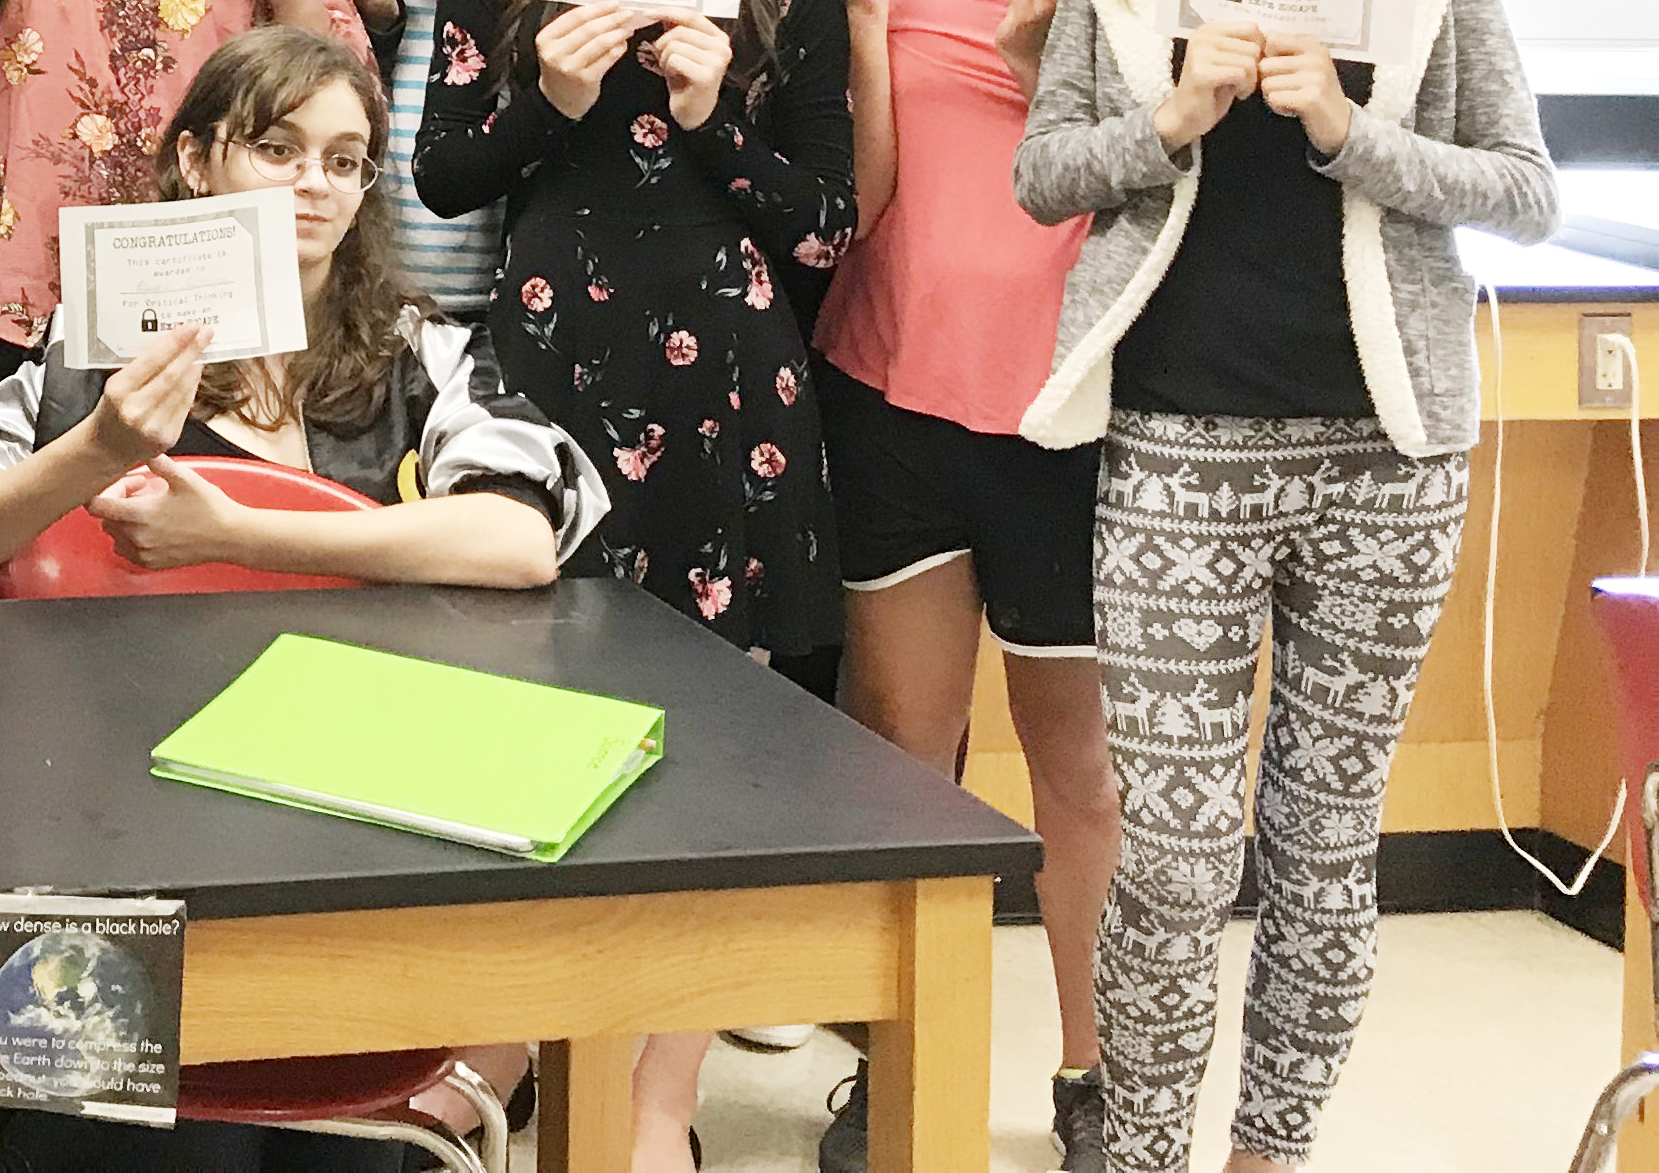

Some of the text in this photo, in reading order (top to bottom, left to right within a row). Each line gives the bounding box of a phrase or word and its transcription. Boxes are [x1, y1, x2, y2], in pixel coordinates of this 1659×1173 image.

[113, 225, 237, 250] CONGRATULATIONS!
[13, 916, 61, 934] dense
[65, 918, 78, 934] is
[81, 920, 92, 934] a
[96, 917, 136, 935] black
[140, 918, 180, 936] hole?
[12, 1035, 48, 1048] were
[51, 1034, 66, 1049] to
[68, 1038, 137, 1055] compress
[140, 1038, 163, 1054] the
[13, 1052, 51, 1068] Earth
[54, 1055, 93, 1071] down
[112, 1055, 136, 1073] the
[138, 1059, 166, 1075] size
[17, 1087, 49, 1102] hole
[126, 1077, 162, 1094] have
